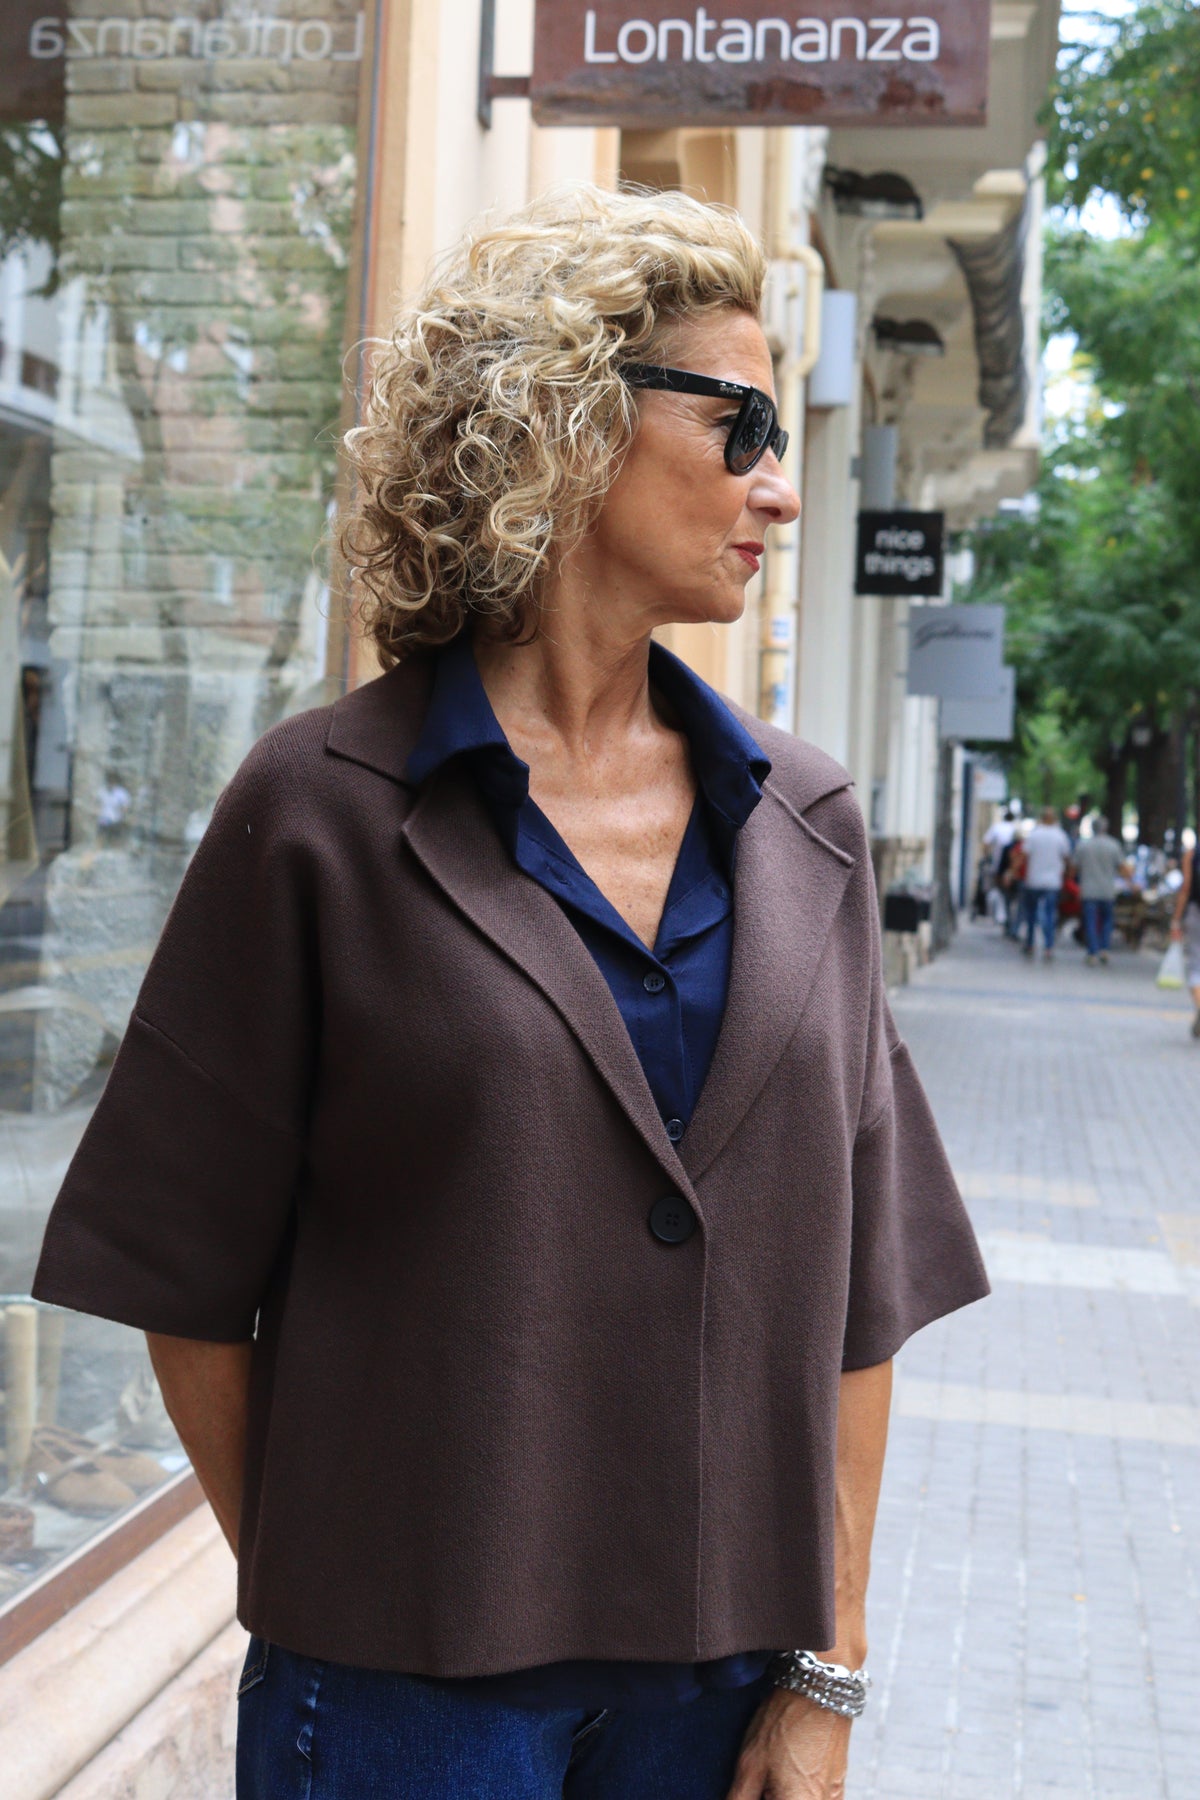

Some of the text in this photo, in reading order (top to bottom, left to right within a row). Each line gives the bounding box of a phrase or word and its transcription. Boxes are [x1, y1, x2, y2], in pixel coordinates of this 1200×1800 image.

[584, 8, 940, 63] Lontananza
[875, 525, 925, 550] nice
[864, 552, 934, 581] things
